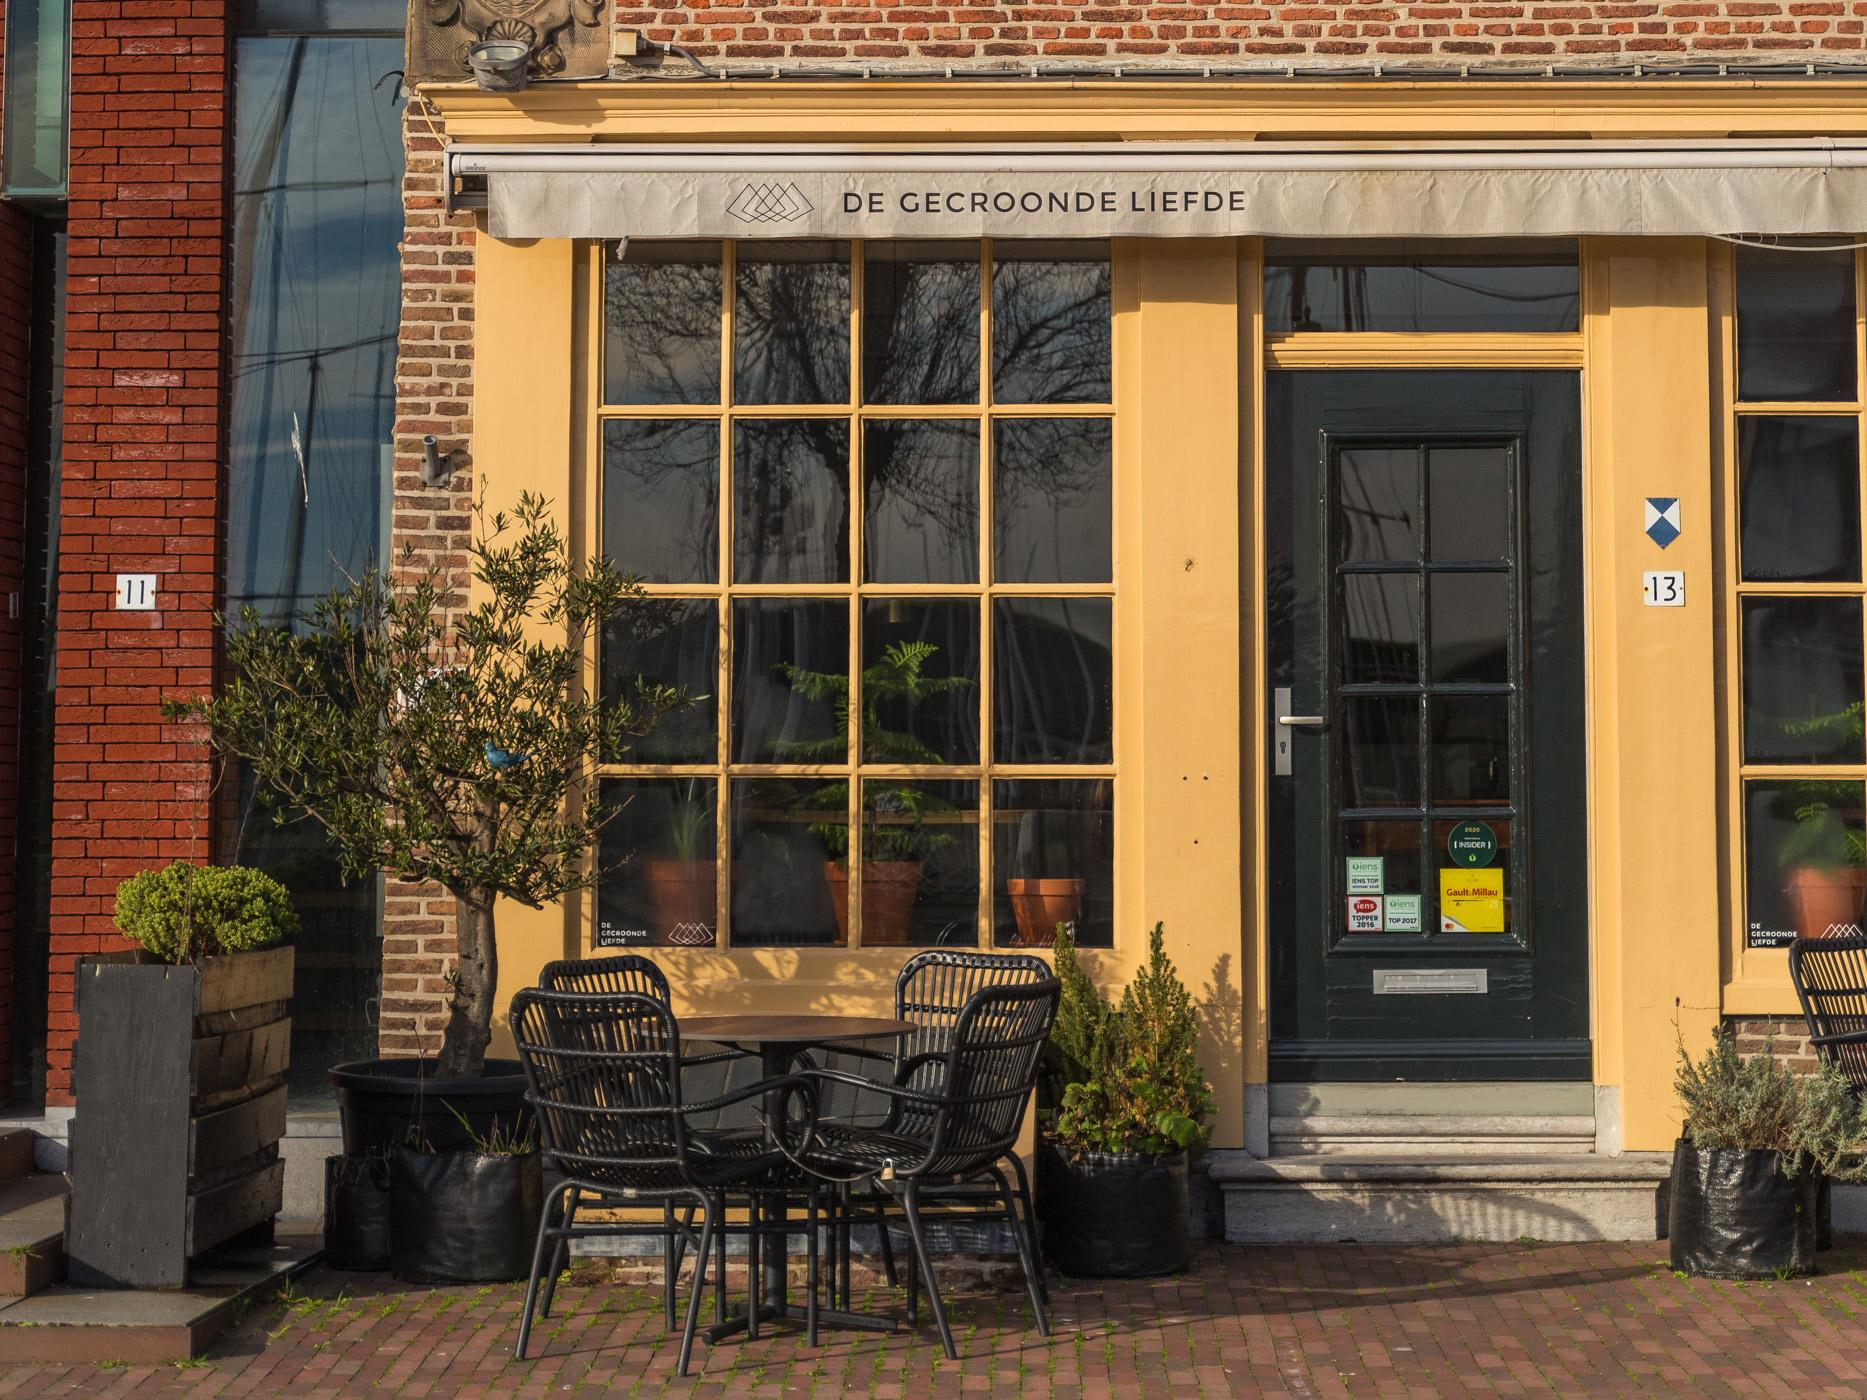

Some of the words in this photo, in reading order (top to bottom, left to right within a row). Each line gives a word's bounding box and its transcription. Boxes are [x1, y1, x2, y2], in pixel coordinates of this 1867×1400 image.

[843, 192, 885, 213] DE
[899, 191, 1118, 213] GECROONDE
[1130, 190, 1246, 212] LIEFDE
[127, 580, 144, 604] 11
[1652, 576, 1677, 602] 13
[1459, 841, 1486, 849] INSIDER
[1356, 901, 1375, 910] iens
